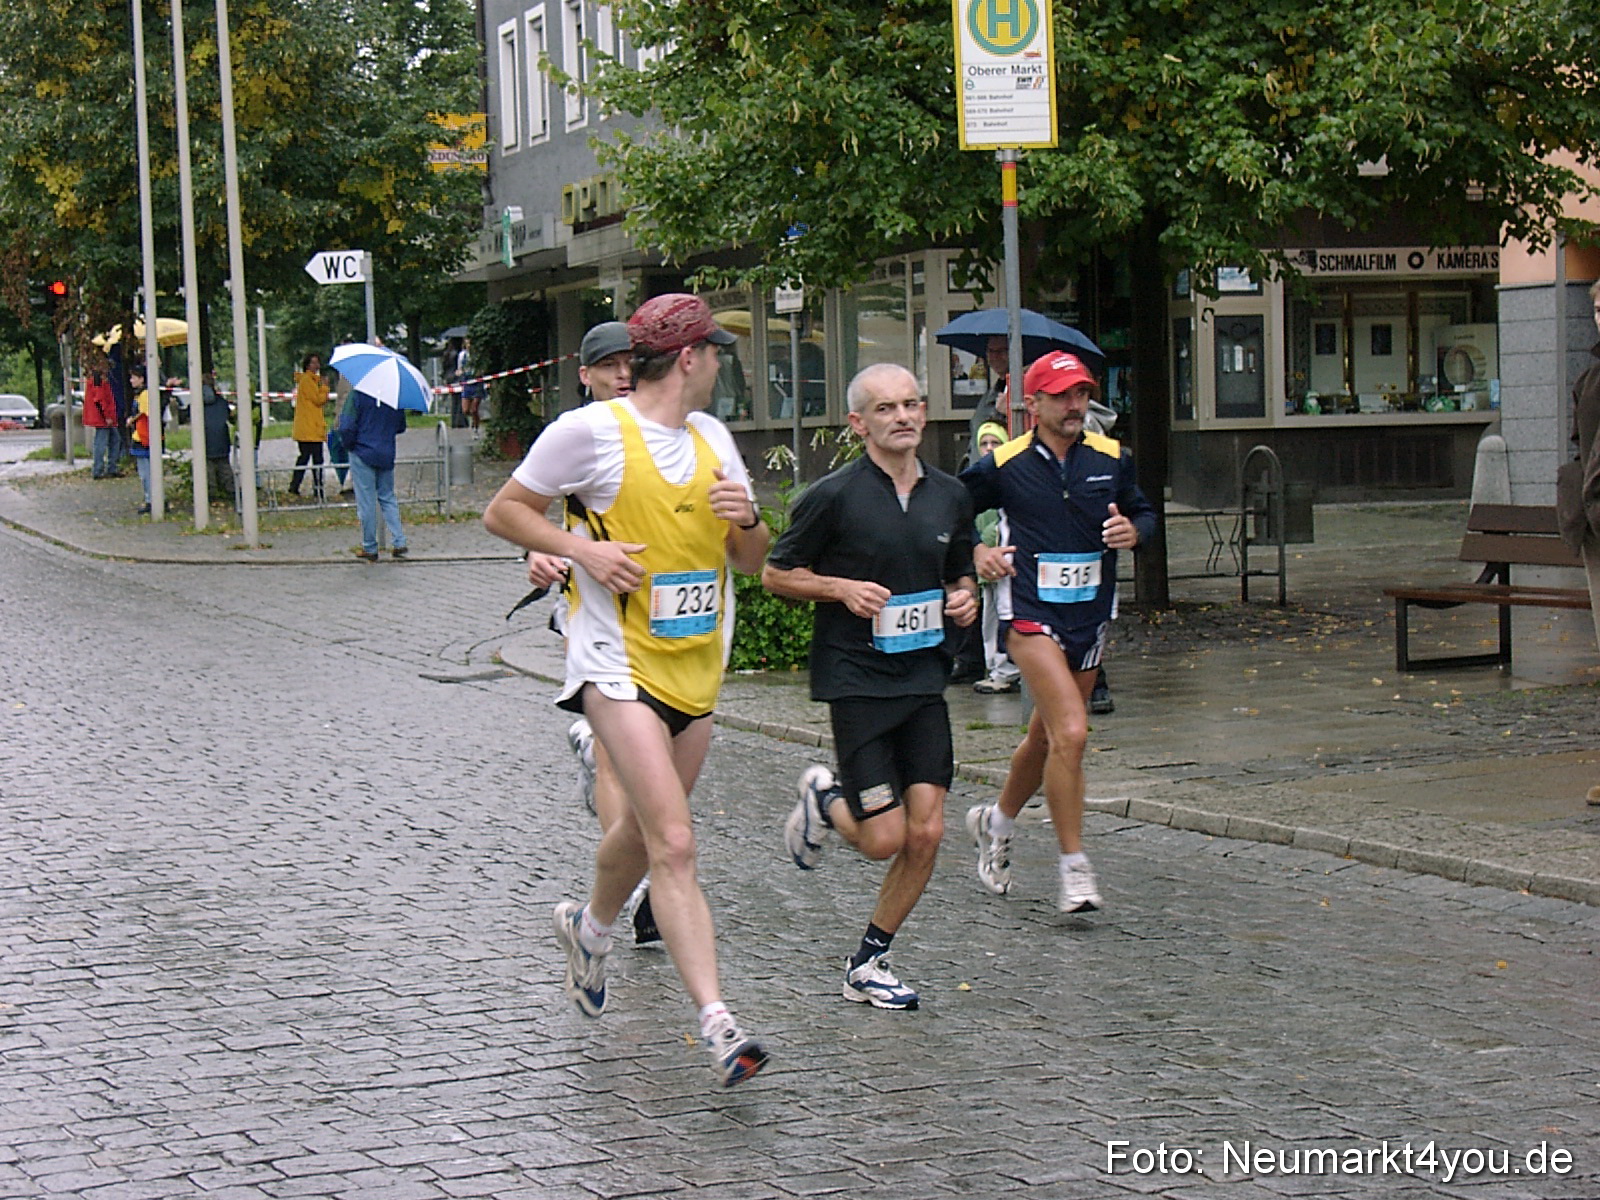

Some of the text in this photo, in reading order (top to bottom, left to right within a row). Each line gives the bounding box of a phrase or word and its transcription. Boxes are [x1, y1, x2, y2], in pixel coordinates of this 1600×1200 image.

[968, 65, 1043, 77] Oberer Markt
[323, 255, 357, 279] WC
[1319, 252, 1499, 272] SCHMALFILM KAMERA'S
[1059, 565, 1091, 586] 515
[676, 584, 715, 616] 232
[896, 605, 929, 632] 461
